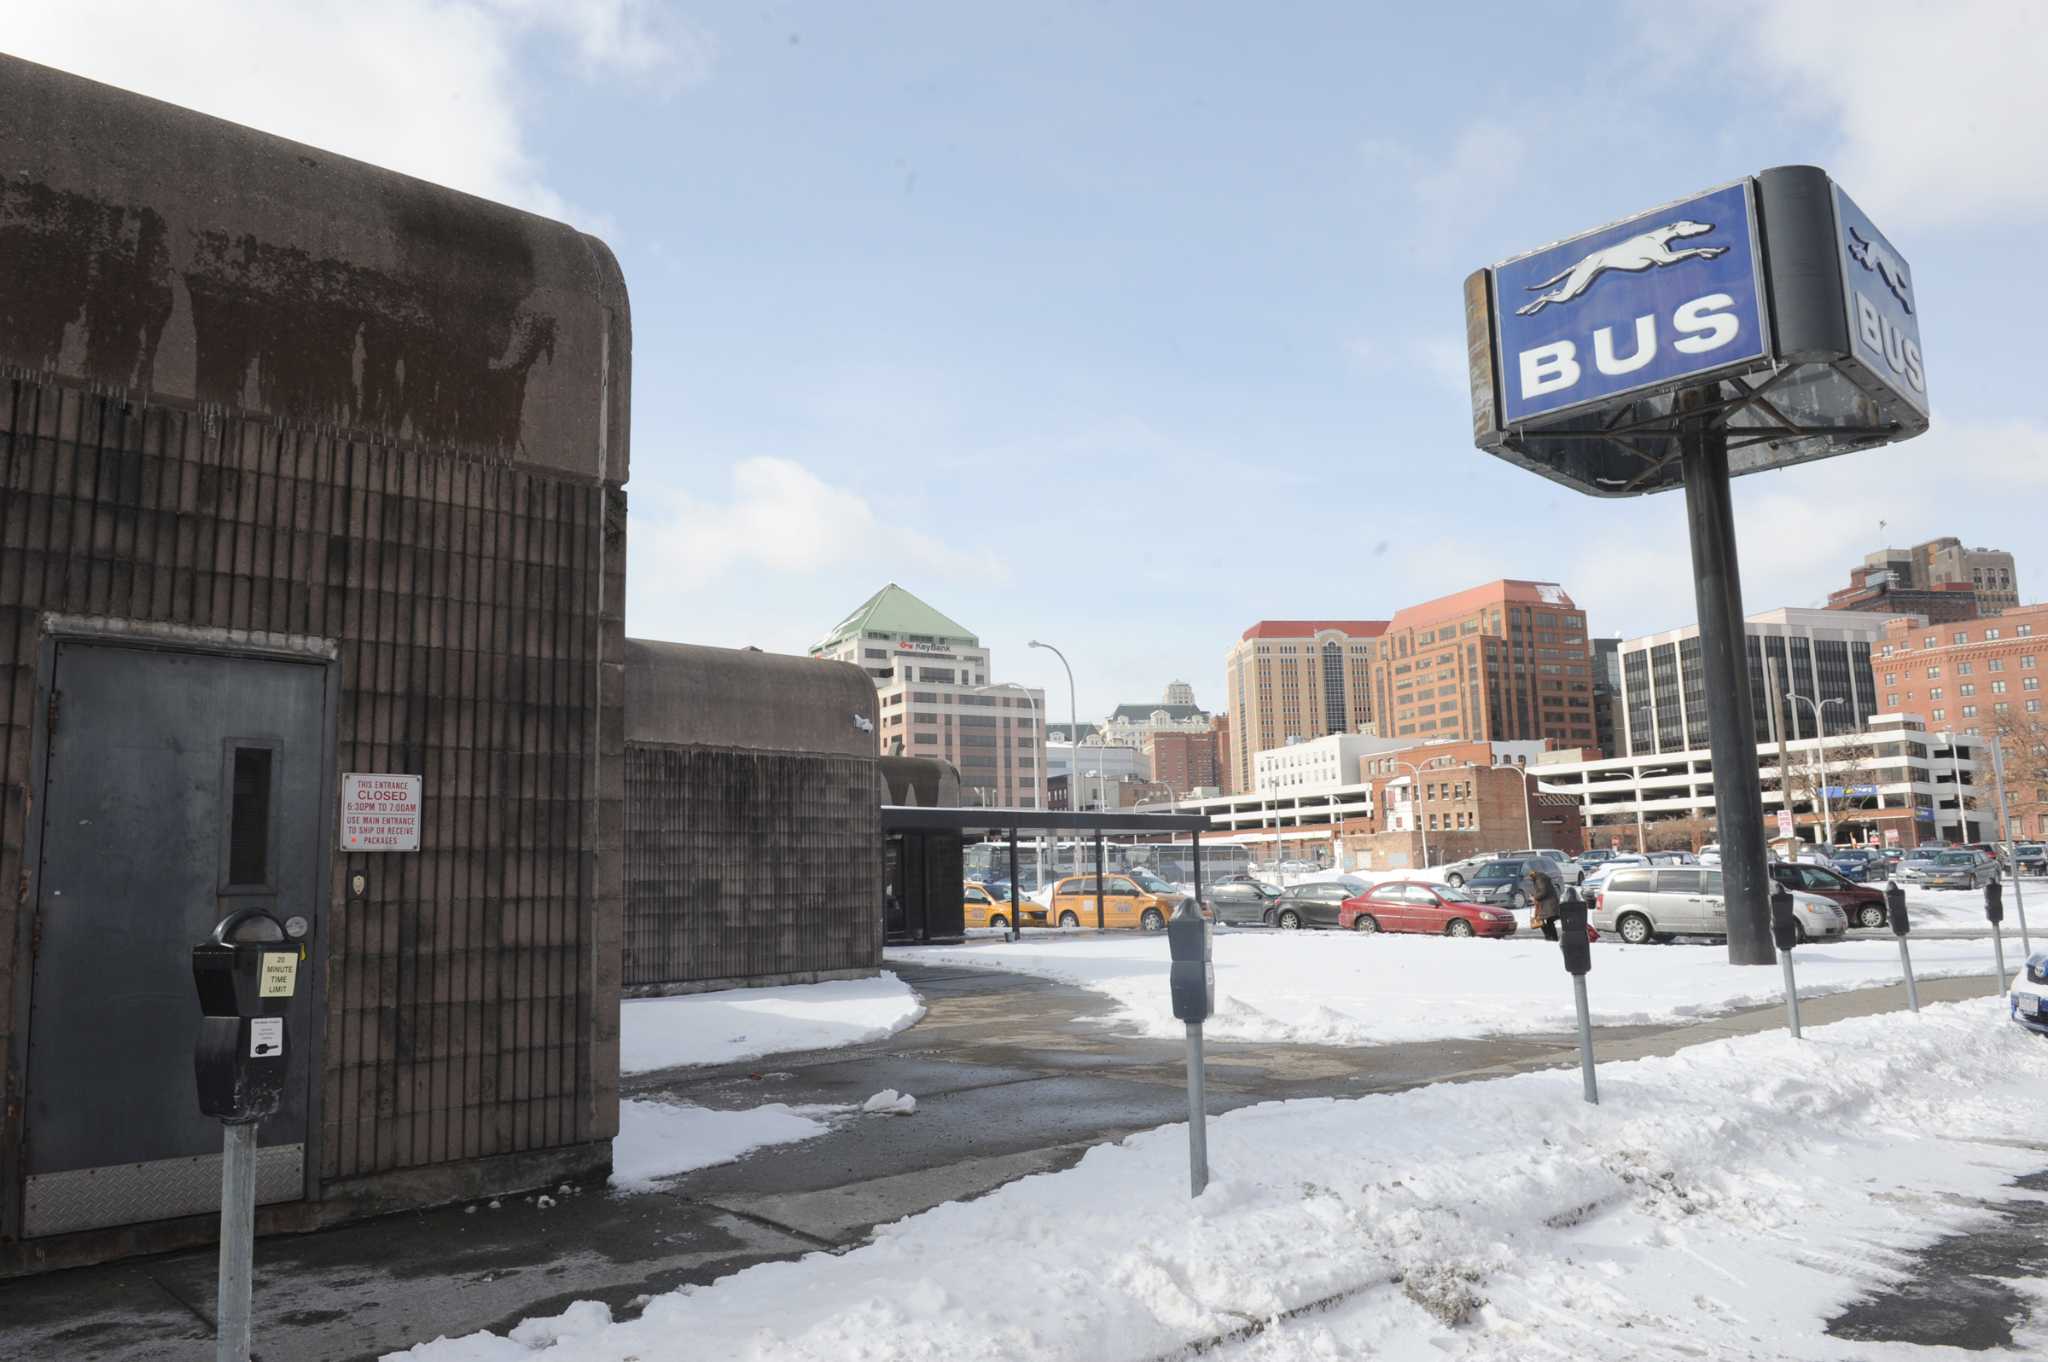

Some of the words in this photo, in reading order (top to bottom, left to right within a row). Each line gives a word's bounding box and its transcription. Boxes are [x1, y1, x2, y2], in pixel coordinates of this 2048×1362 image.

[1855, 290, 1924, 393] BUS
[1520, 293, 1740, 400] BUS
[914, 641, 951, 653] KeyBank
[358, 780, 372, 789] THIS
[375, 781, 408, 790] ENTRANCE
[358, 790, 407, 801] CLOSED
[378, 803, 387, 812] TO
[346, 816, 360, 825] USE
[362, 816, 380, 825] MAIN
[382, 816, 416, 825] ENTRANCE
[348, 826, 357, 834] TO
[359, 826, 374, 834] SHIP
[376, 826, 385, 834] OR
[387, 827, 414, 835] RECEIVE
[364, 836, 398, 844] PACKAGES
[266, 966, 293, 974] MINUTE
[271, 975, 288, 983] TIME
[268, 985, 287, 993] LIMIT
